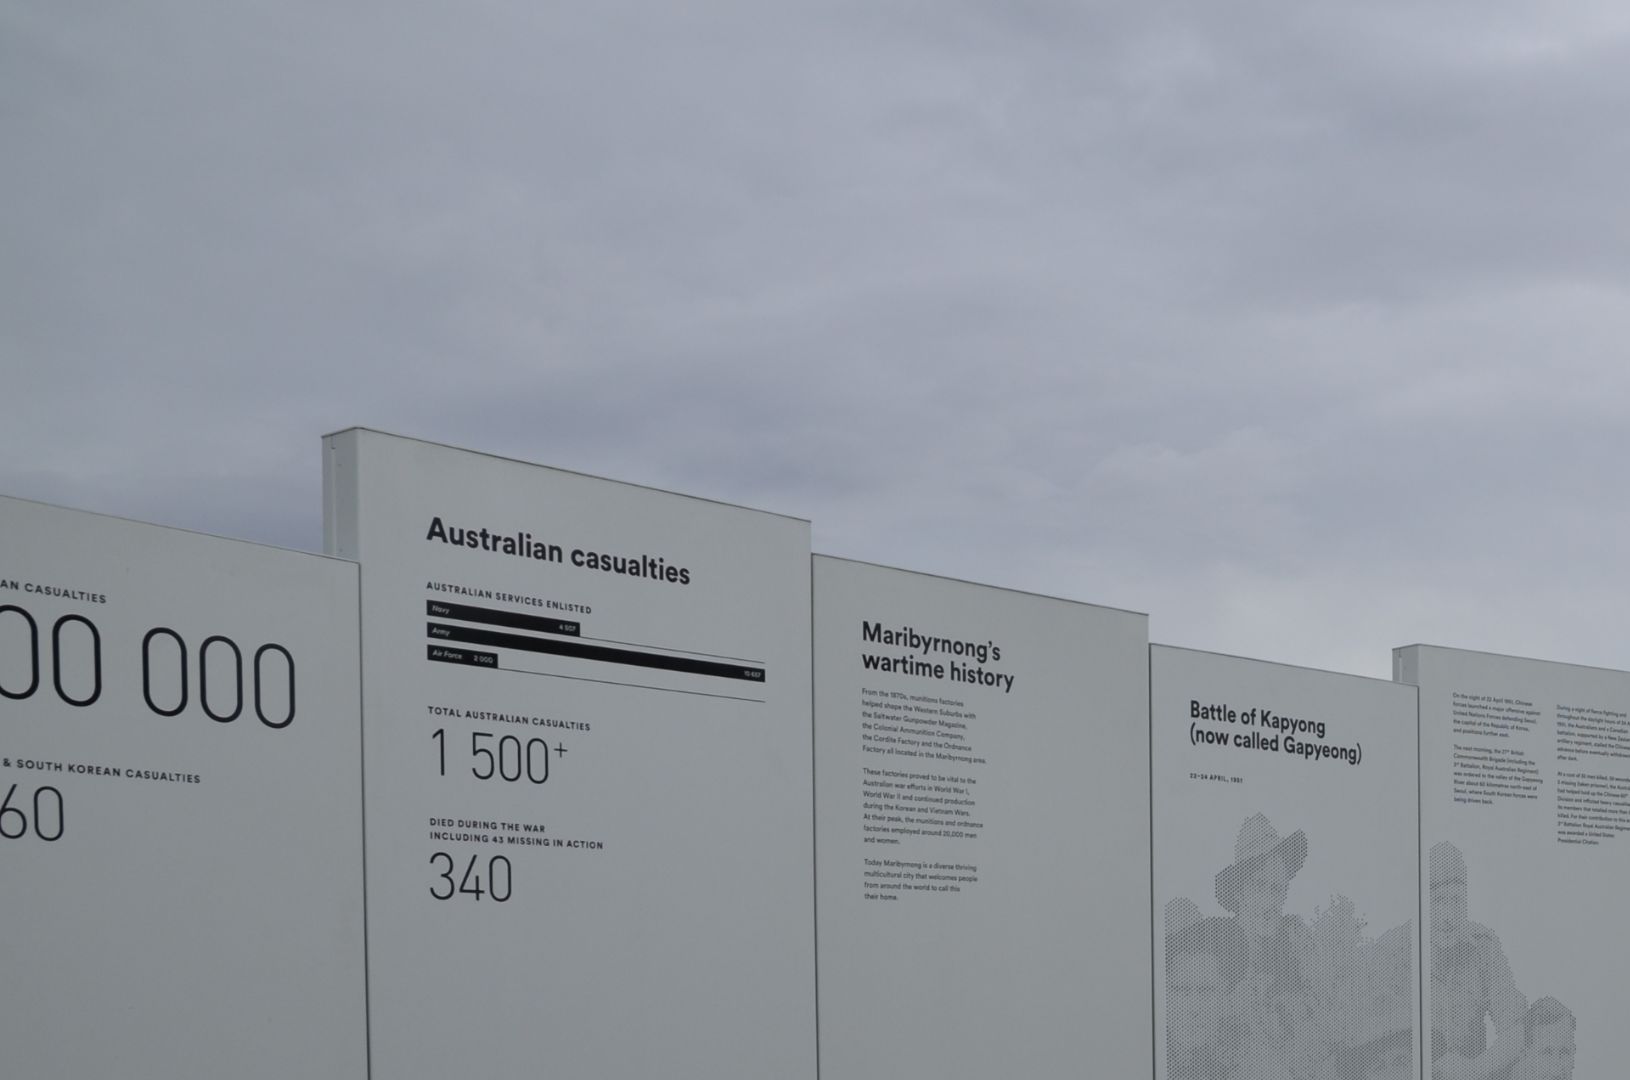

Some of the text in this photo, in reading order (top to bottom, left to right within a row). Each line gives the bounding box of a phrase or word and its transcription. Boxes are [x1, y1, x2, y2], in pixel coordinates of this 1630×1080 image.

[426, 517, 691, 585] Australian casualties
[24, 583, 107, 604] CASUALTIES
[426, 582, 592, 614] AUSTRALIAN SERVICES ENLISTED
[431, 604, 450, 615] Navy
[432, 626, 451, 637] Army
[432, 649, 463, 660] Air Force
[142, 627, 295, 729] 000
[862, 653, 1015, 693] wartime history
[862, 688, 878, 696] From
[939, 698, 964, 707] factories
[862, 699, 883, 708] helped
[884, 702, 902, 711] shape
[428, 706, 591, 731] TOTAL AUSTRALIAN CASUALTIES
[903, 715, 937, 725] Gunpowder
[1190, 700, 1326, 738] Battle of Kapyong
[862, 722, 872, 730] the
[873, 723, 899, 732] Colonial
[900, 726, 935, 736] Ammunition
[874, 734, 896, 743] Cordite
[898, 737, 920, 747] Factory
[1190, 722, 1362, 765] (now called Gapyeong)
[432, 728, 445, 776] 1
[862, 745, 886, 755] Factory
[895, 748, 917, 756] located
[3, 758, 200, 784] & SOUTH KOREAN CASUALTIES
[863, 768, 881, 776] These
[882, 769, 908, 778] factories
[863, 779, 893, 788] Australian
[907, 783, 926, 791] efforts
[934, 785, 952, 793] World
[863, 790, 882, 798] World
[882, 792, 895, 800] War
[914, 796, 943, 804] continued
[944, 798, 975, 806] production
[0, 783, 64, 842] 60
[863, 802, 883, 811] during
[895, 804, 916, 812] Korean
[929, 807, 953, 815] Vietnam
[430, 818, 546, 833] DIED DURING THE WAR
[864, 824, 890, 832] factories
[430, 832, 604, 850] INCLUDING 43 MISSING IN ACTION
[864, 858, 882, 867] Today
[933, 862, 954, 870] diverse
[429, 852, 512, 902] 340
[903, 872, 914, 881] city
